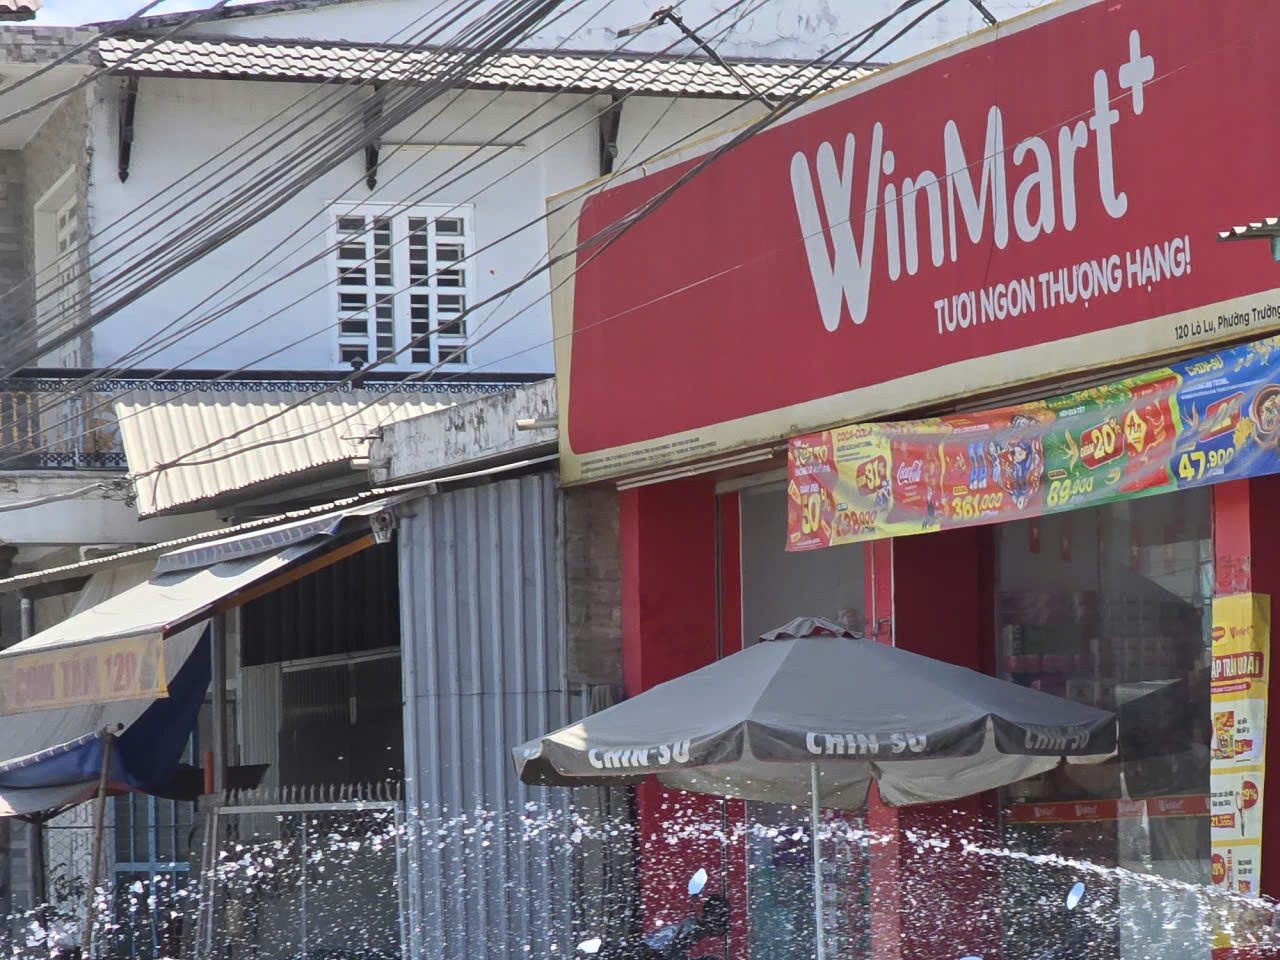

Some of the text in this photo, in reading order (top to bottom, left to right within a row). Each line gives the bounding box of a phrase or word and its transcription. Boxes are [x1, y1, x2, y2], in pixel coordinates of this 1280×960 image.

[934, 235, 1192, 334] TƯƠI NGON THƯỢNG HẠNG!
[1175, 325, 1189, 340] 120
[1190, 321, 1202, 337] Lò
[1203, 319, 1217, 334] Lu,
[1217, 312, 1250, 330] Phường
[587, 738, 691, 769] CHIN-SU
